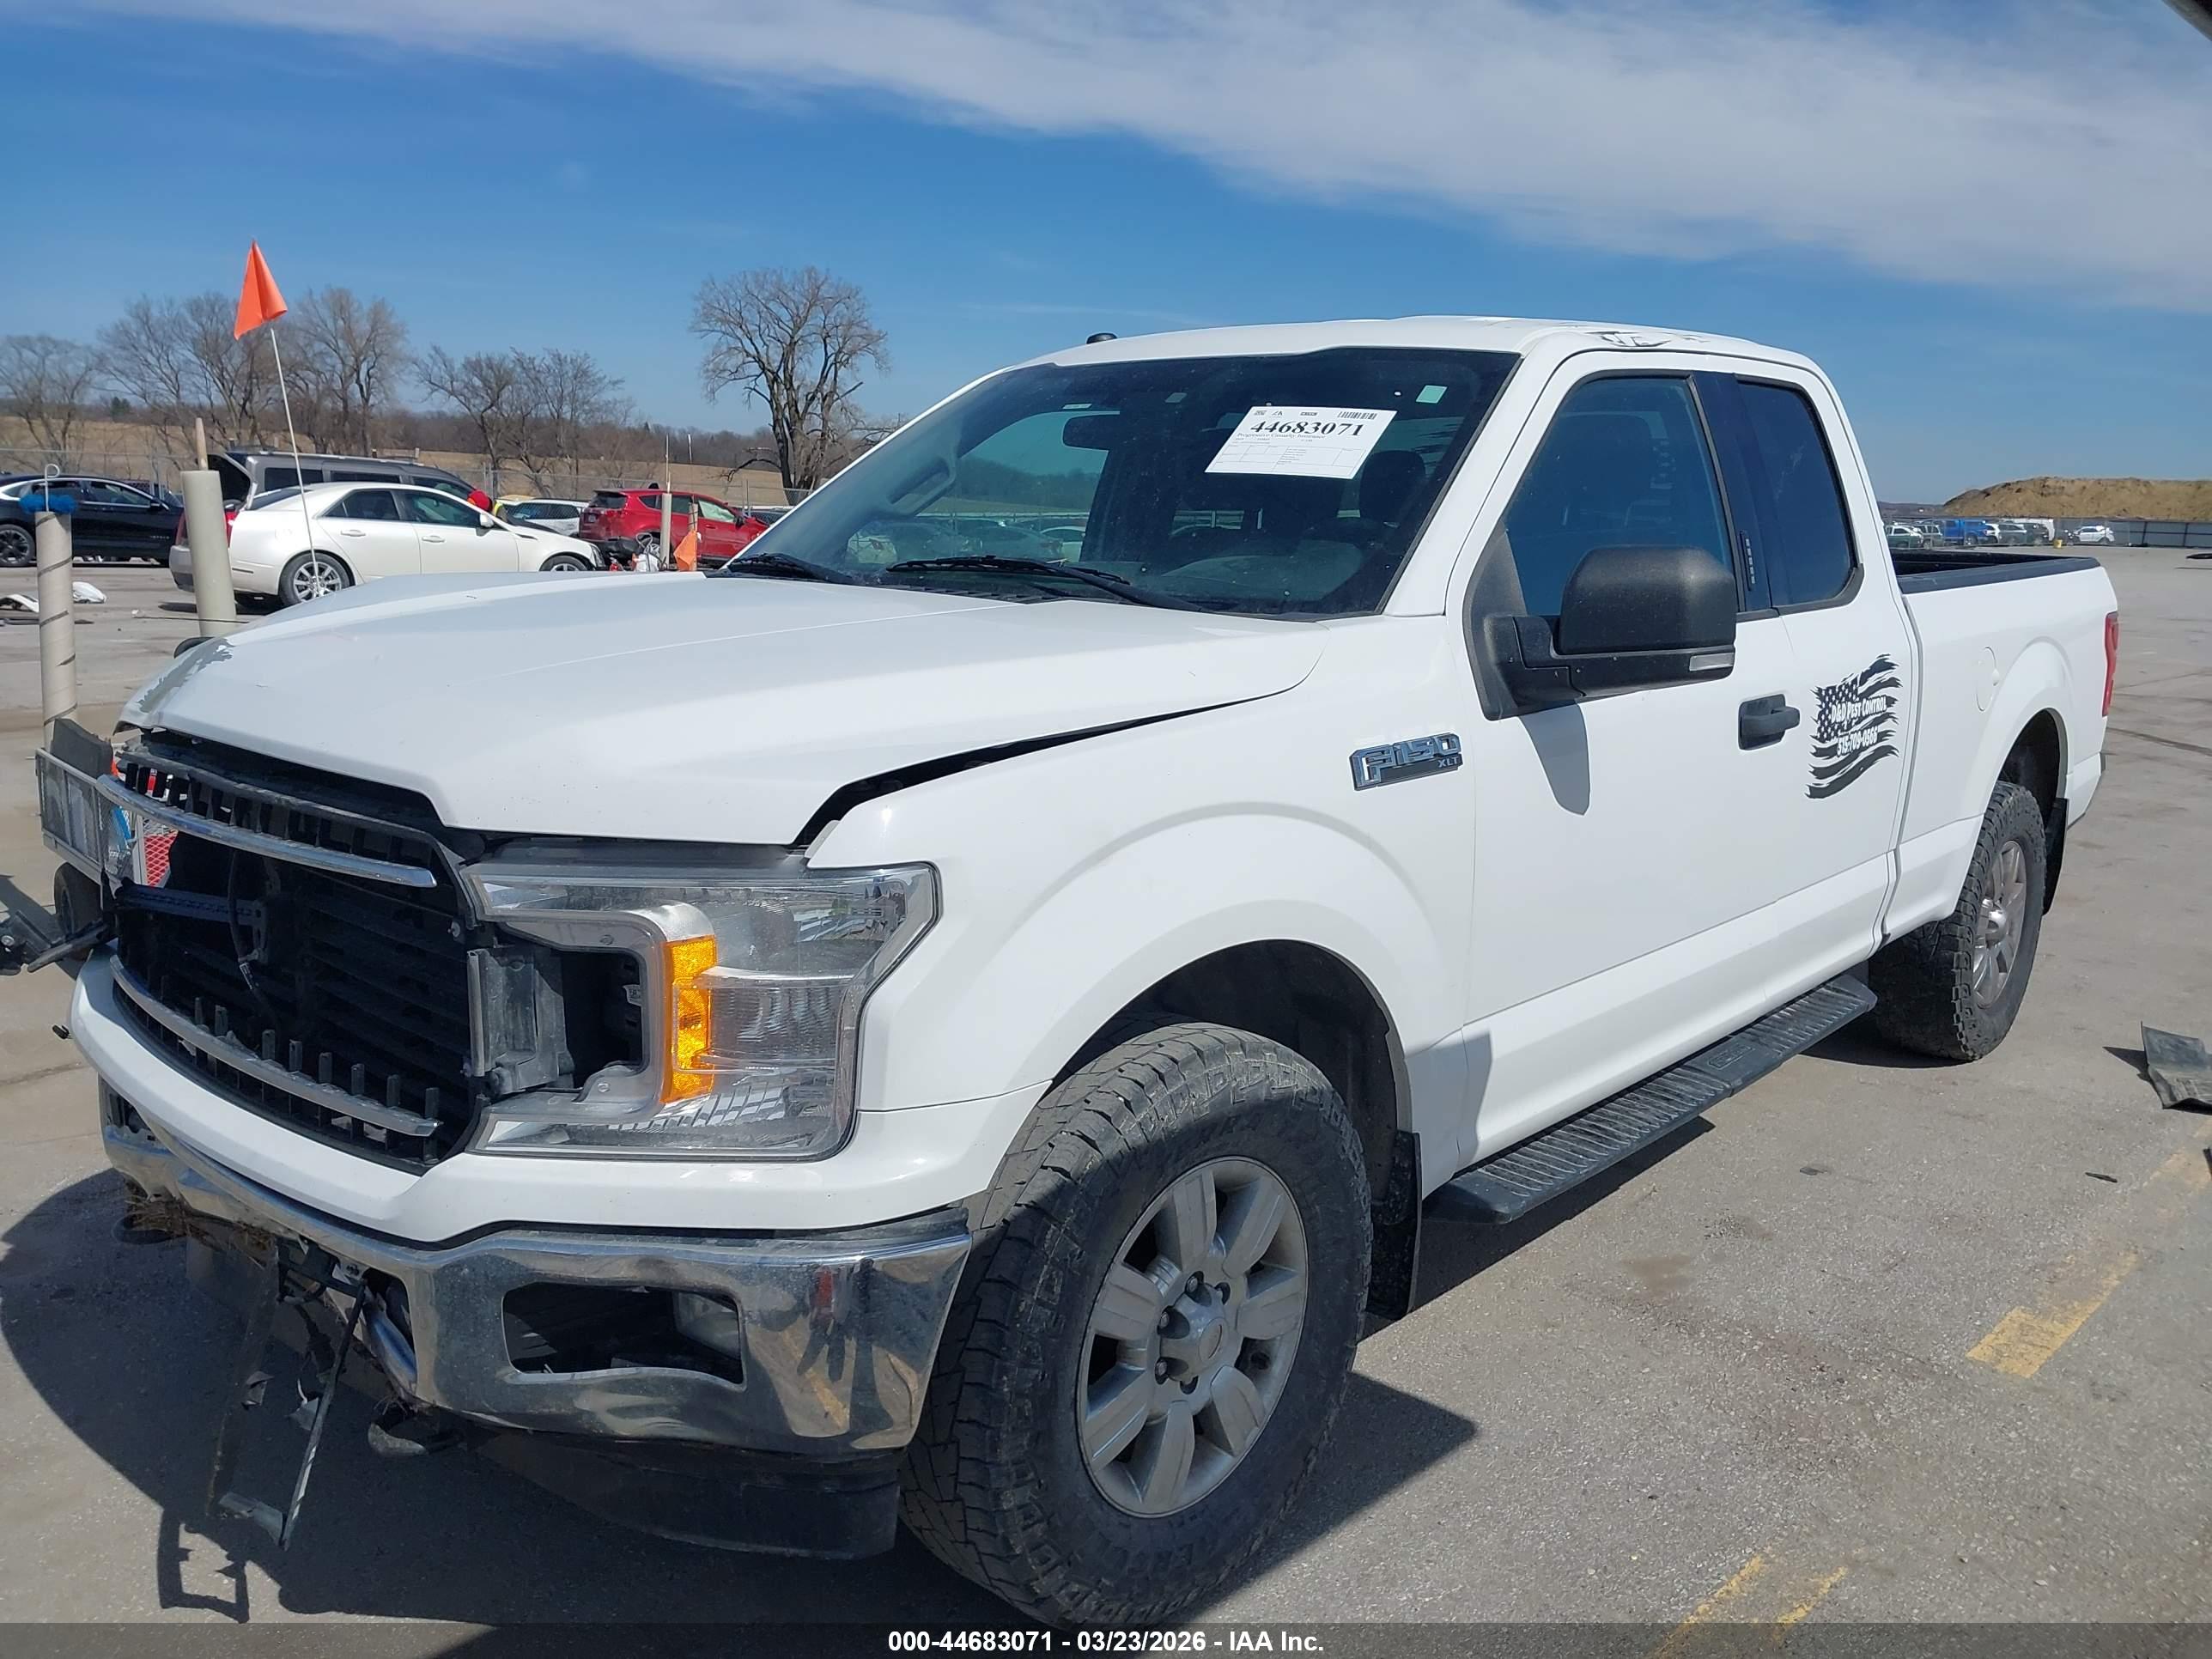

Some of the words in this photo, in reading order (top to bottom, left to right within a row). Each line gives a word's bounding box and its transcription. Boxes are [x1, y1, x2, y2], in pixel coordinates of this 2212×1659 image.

[1250, 421, 1364, 437] 44683071
[1831, 702, 1846, 724] D&D
[1846, 701, 1862, 720] PEST
[1862, 696, 1887, 716] CONTROL
[1438, 757, 1458, 768] XLT
